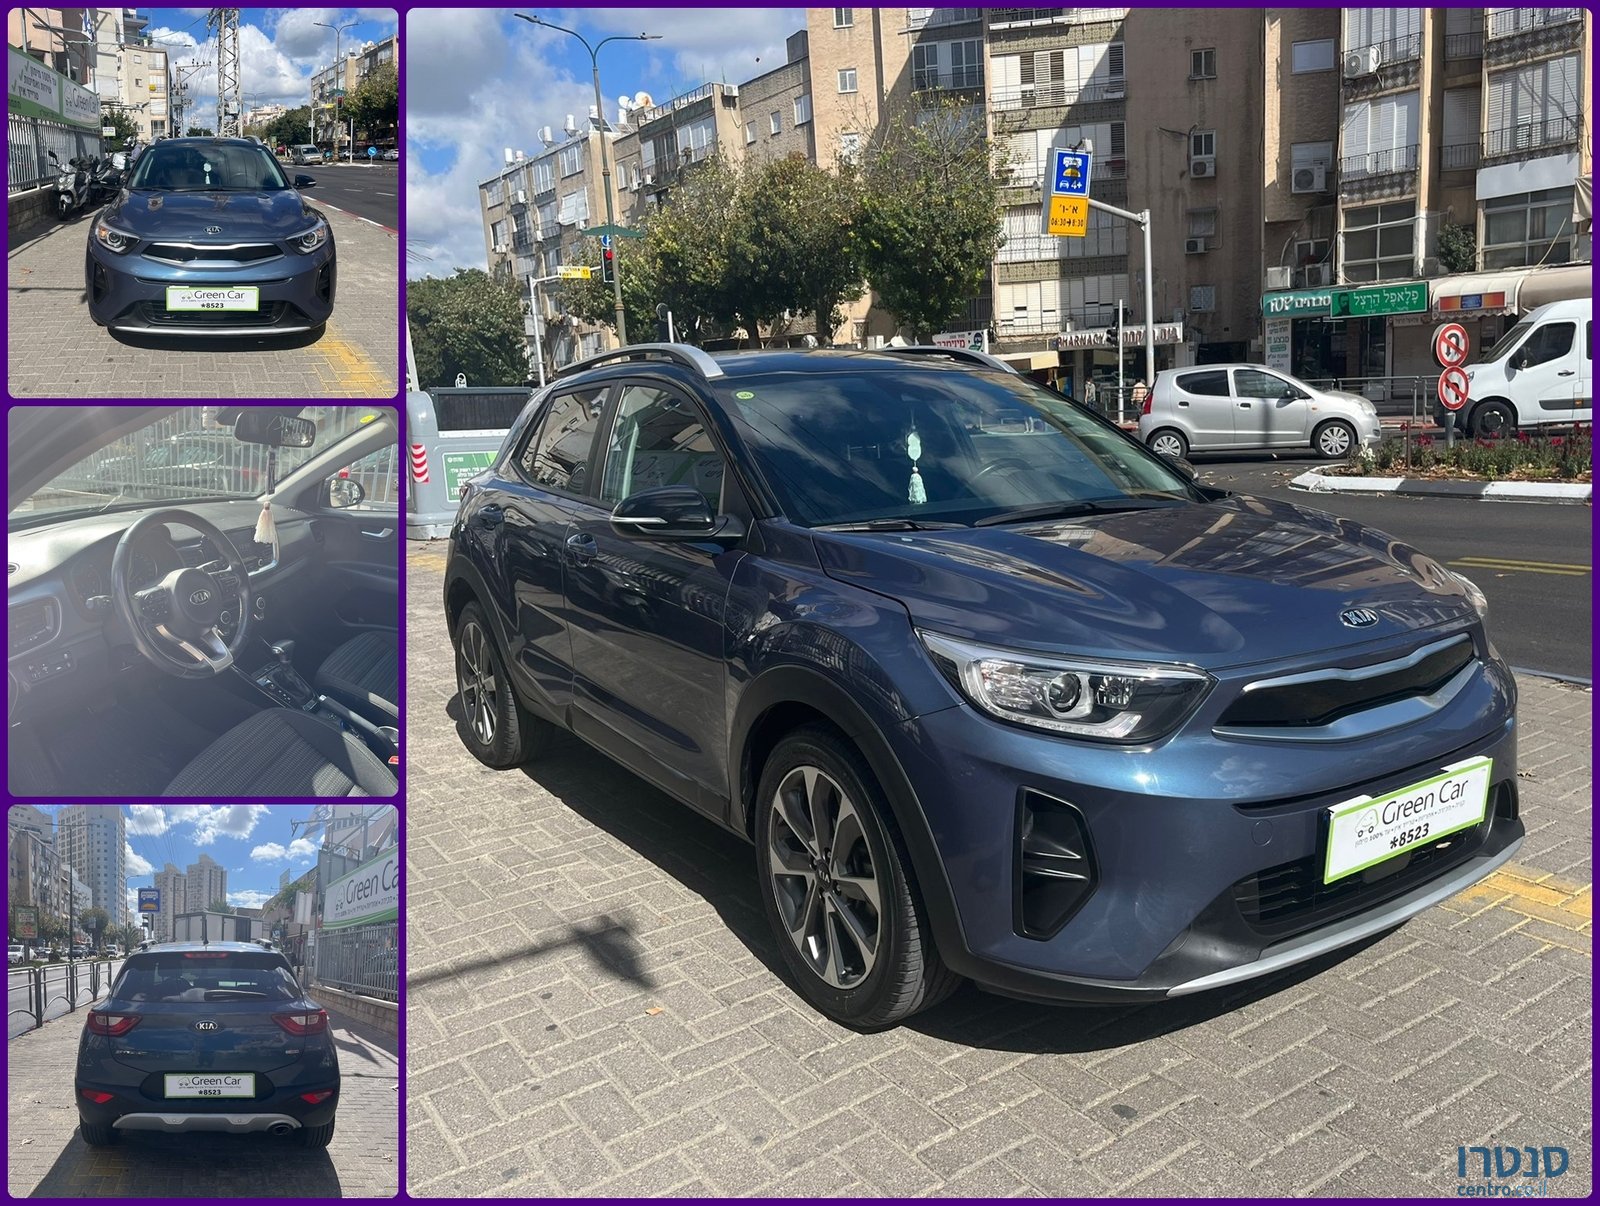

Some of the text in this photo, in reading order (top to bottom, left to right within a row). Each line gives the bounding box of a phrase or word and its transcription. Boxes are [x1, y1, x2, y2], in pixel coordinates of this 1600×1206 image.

[194, 290, 245, 299] Green Car
[1344, 609, 1377, 625] KIA
[1382, 780, 1468, 825] Green Car
[346, 860, 398, 905] Green Ca
[191, 1076, 241, 1086] Green Car
